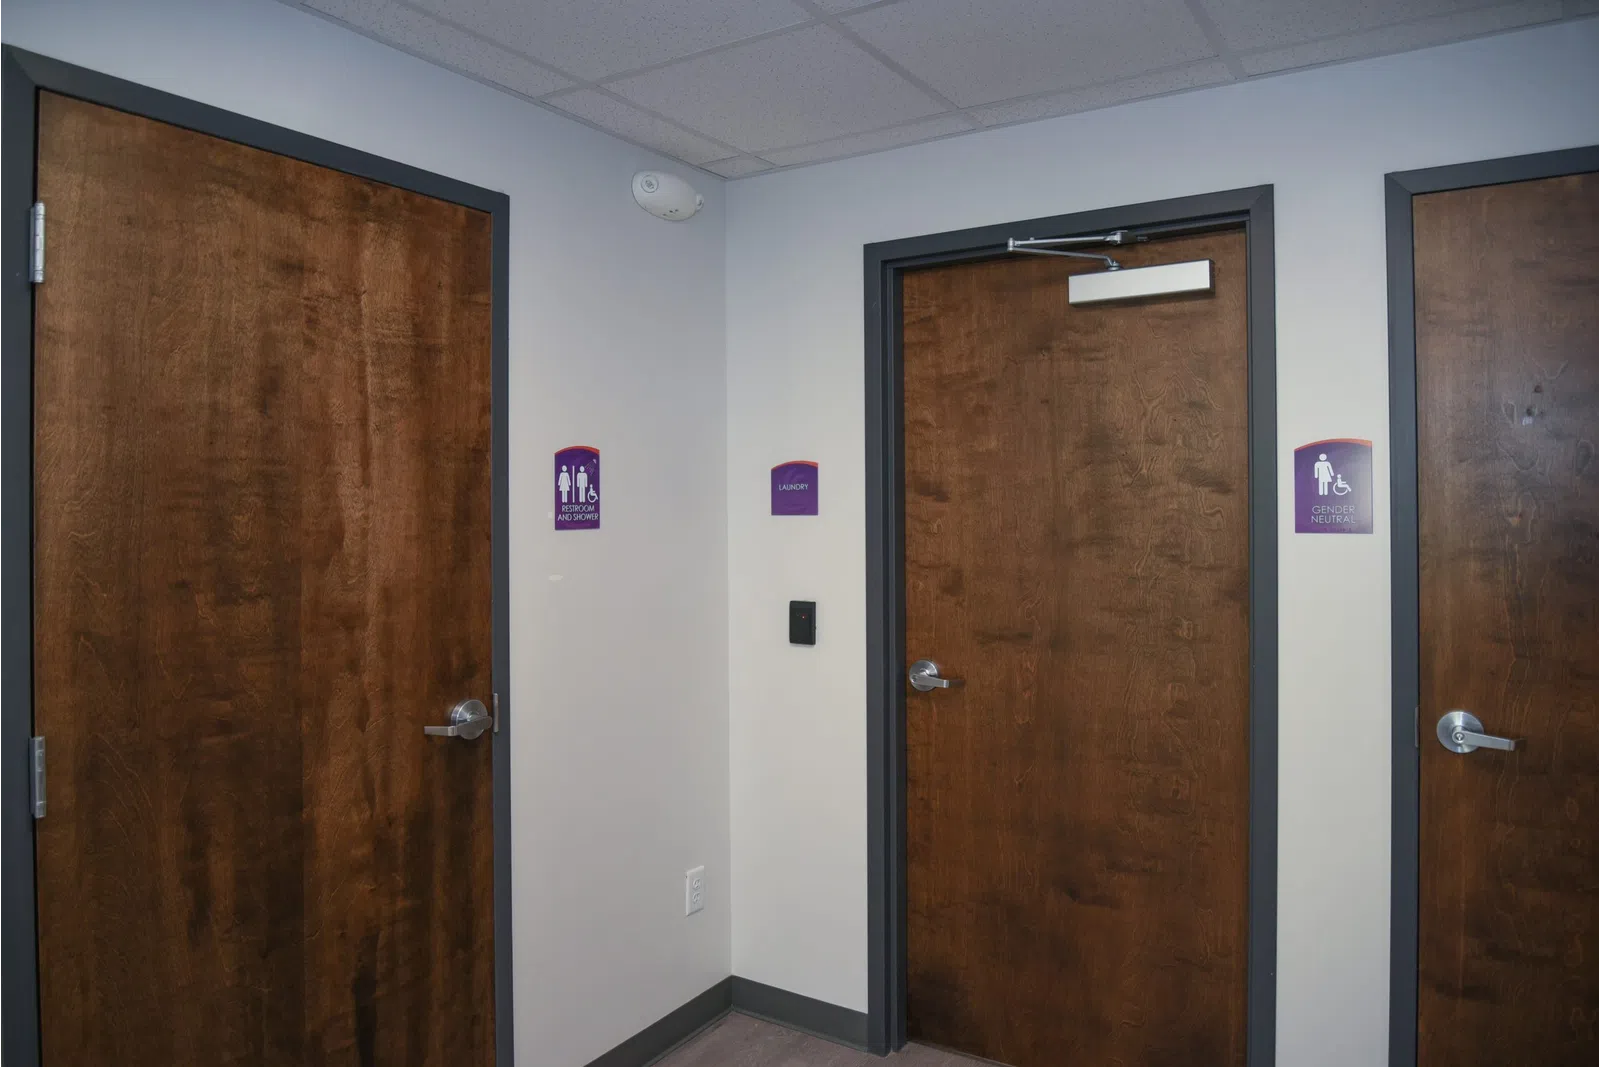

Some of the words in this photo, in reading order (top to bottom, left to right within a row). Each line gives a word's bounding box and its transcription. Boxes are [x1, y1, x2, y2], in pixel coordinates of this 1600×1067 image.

[778, 483, 809, 491] LAUNDRY
[561, 504, 595, 513] RESTROOM
[1311, 505, 1355, 514] GENDER
[557, 513, 572, 521] AND
[573, 513, 599, 521] SHOWER
[1311, 515, 1356, 524] NEUTRAL
